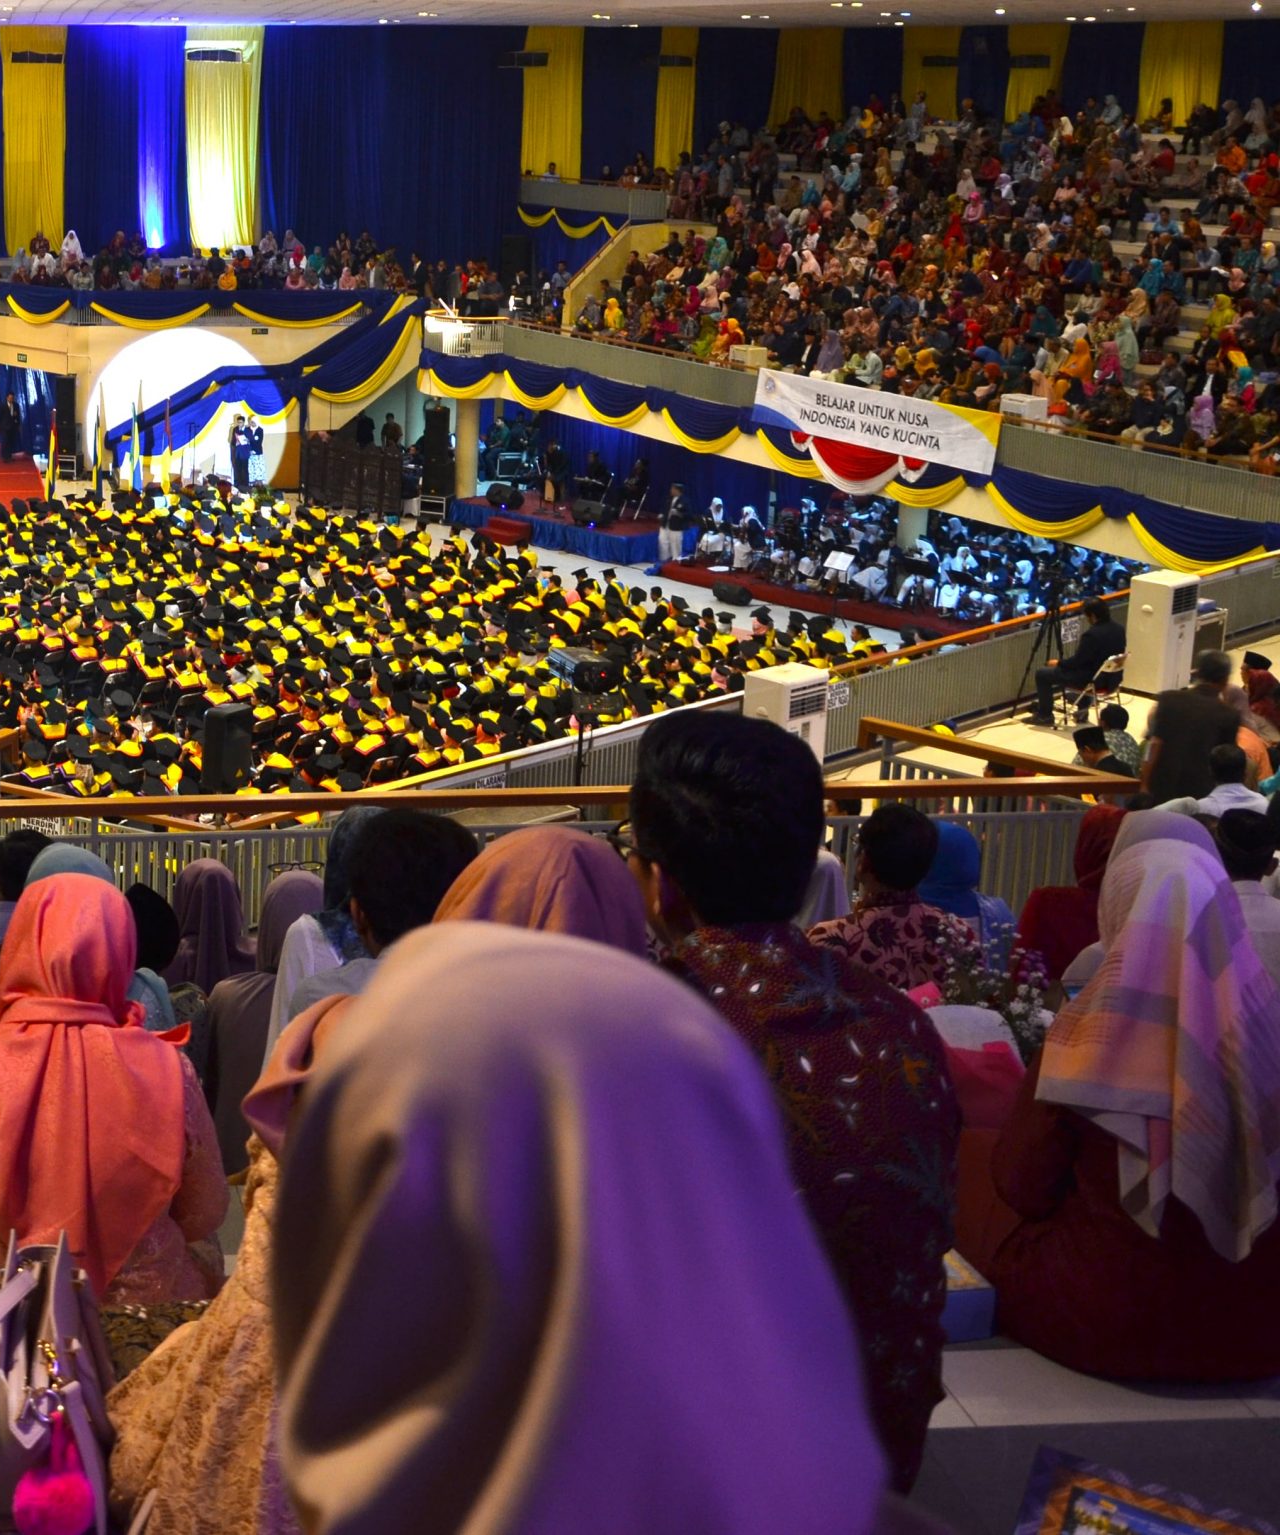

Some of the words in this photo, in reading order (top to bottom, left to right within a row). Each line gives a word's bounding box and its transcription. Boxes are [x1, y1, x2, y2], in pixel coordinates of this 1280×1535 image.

[800, 408, 856, 431] INDONESIA
[860, 421, 890, 439] YANG
[892, 428, 941, 450] KUCINTA
[816, 393, 856, 413] BELAJAR
[858, 402, 895, 421] UNTUK
[898, 410, 930, 428] NUSA
